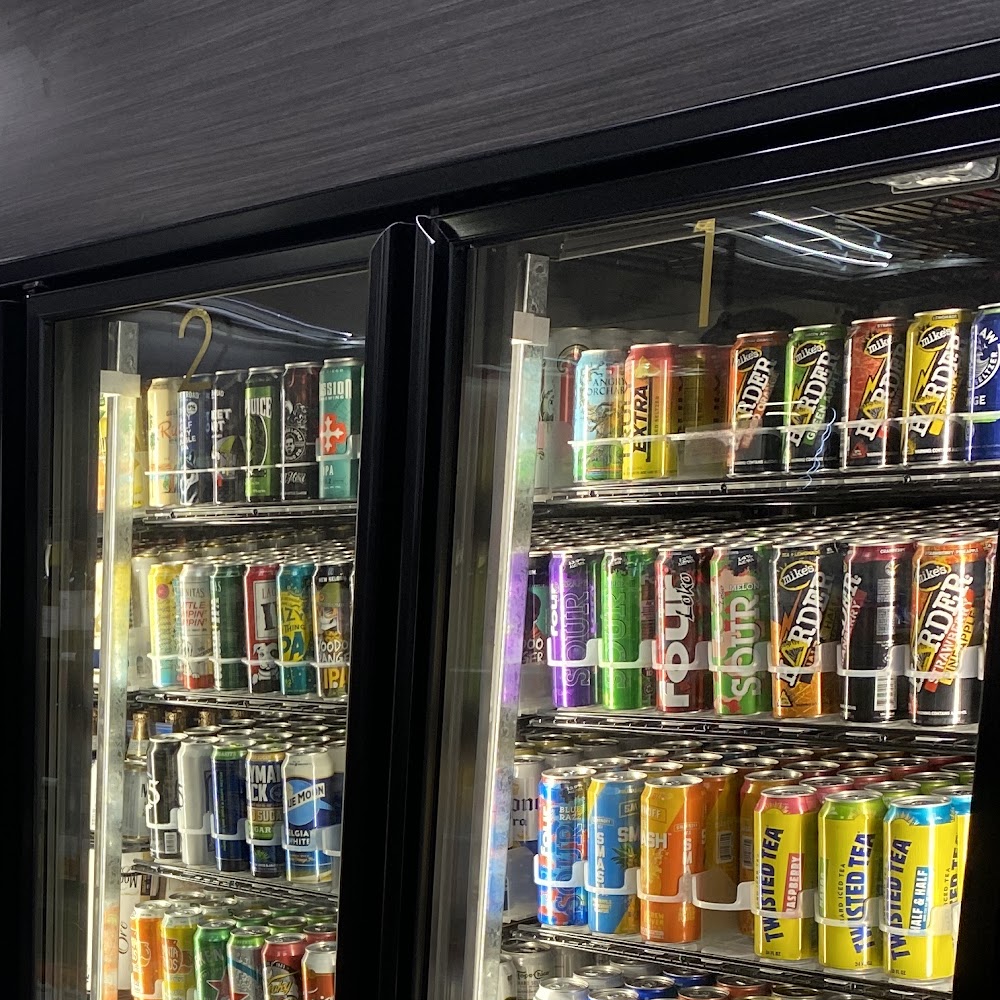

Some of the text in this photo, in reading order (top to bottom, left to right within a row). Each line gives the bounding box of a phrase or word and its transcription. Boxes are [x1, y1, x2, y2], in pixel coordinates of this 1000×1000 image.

[178, 308, 213, 392] 2
[794, 342, 825, 363] mike's
[920, 327, 953, 347] mike's
[587, 386, 626, 396] ORCHAR
[634, 384, 648, 453] EXTRA
[781, 564, 815, 586] mike's
[675, 572, 696, 623] Loko
[730, 594, 760, 697] SOUR
[297, 784, 325, 803] MOON
[760, 826, 785, 942] TWISTED TEA
[846, 833, 876, 954] TWISTED TEA
[887, 838, 912, 960] TWISTED TEA
[917, 868, 928, 893] HALF
[916, 895, 925, 906] &
